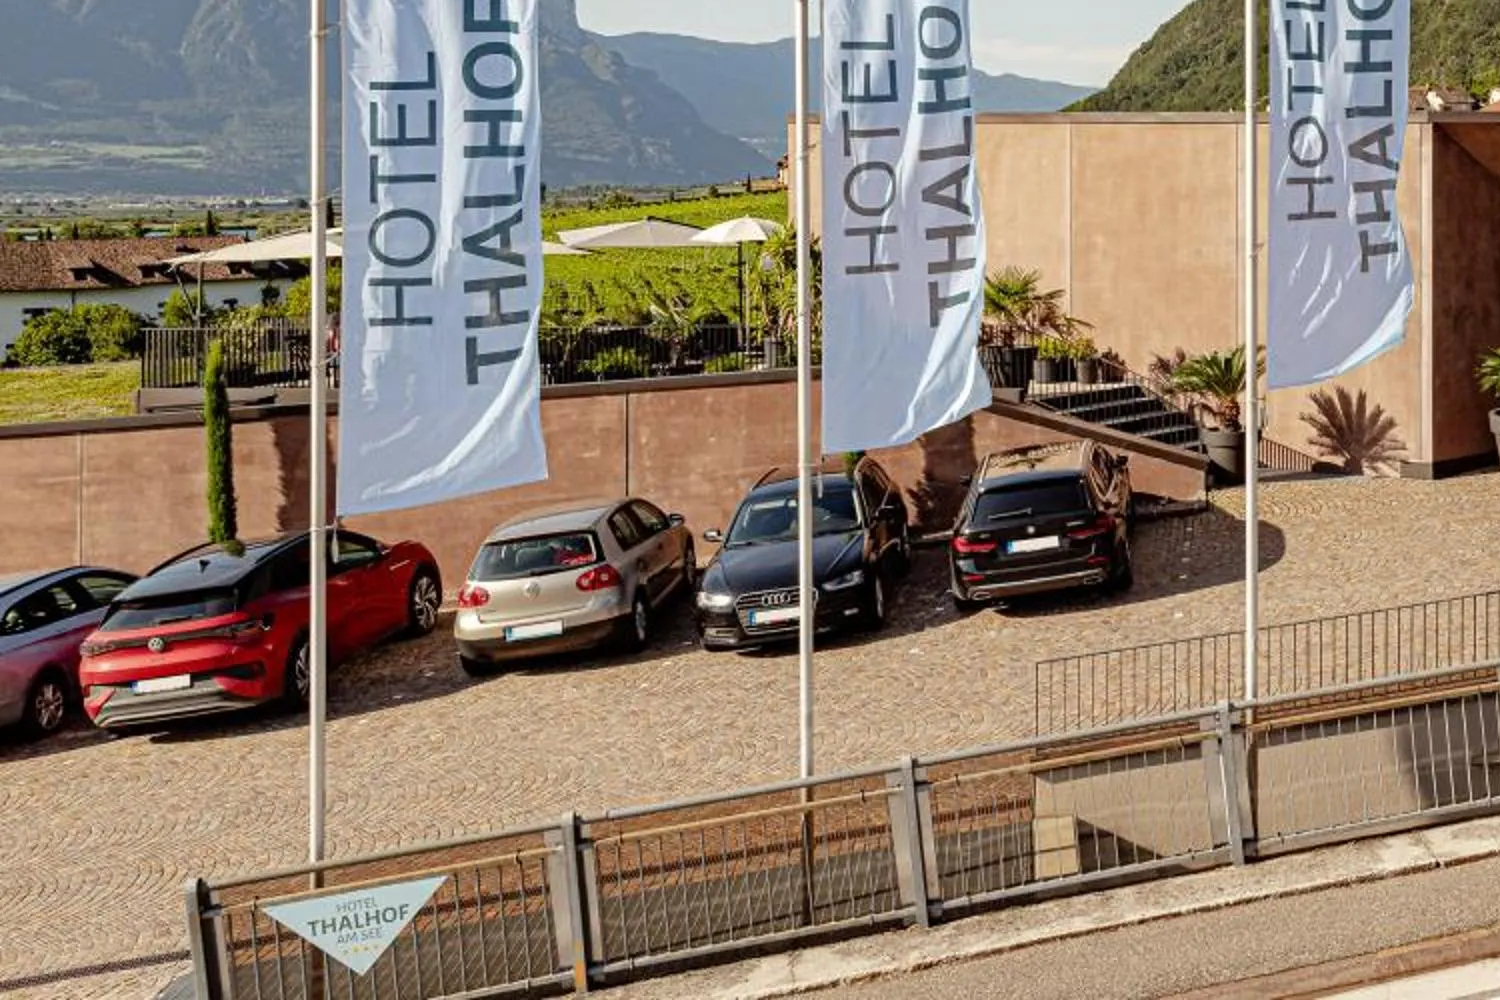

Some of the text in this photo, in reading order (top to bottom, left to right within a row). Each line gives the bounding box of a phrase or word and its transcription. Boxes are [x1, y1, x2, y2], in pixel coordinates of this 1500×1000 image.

[840, 13, 901, 277] HOTEL
[368, 51, 438, 328] HOTEL
[307, 903, 410, 937] THALHOF
[335, 896, 378, 913] HOTEL
[337, 926, 383, 944] AM SEE
